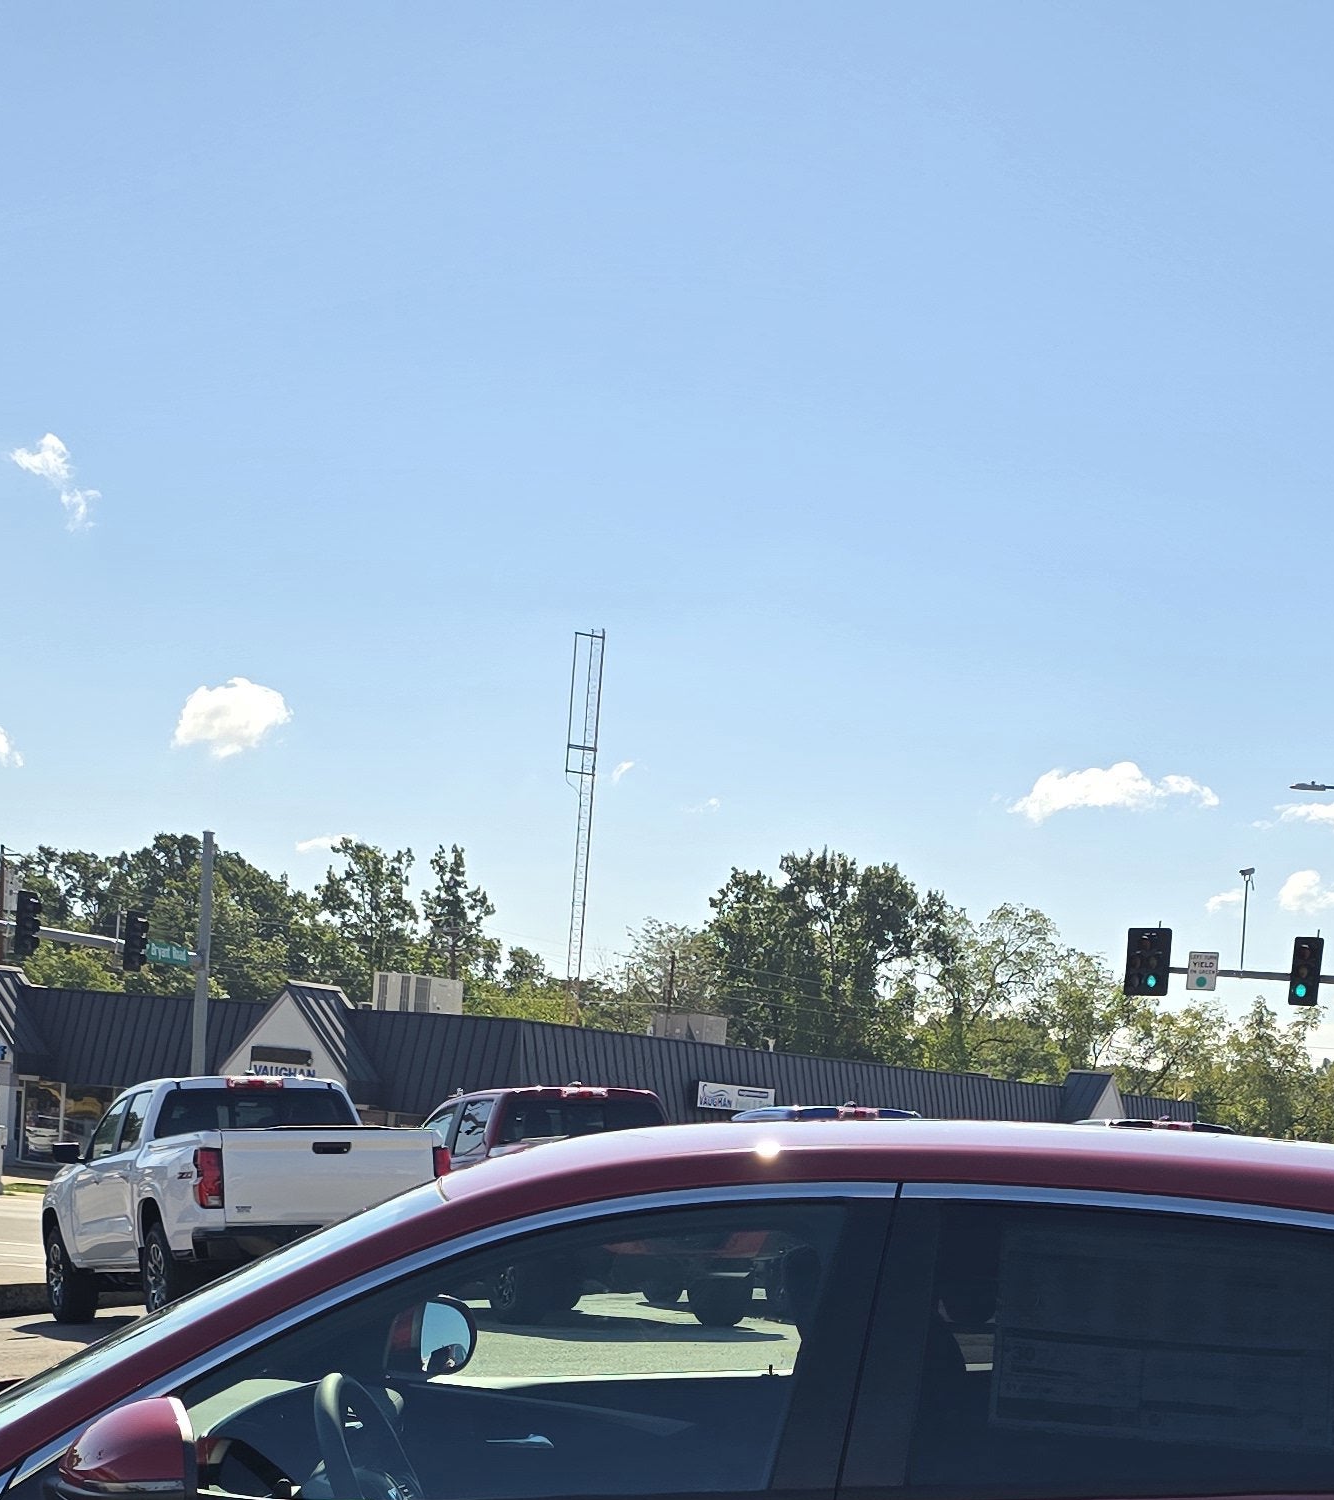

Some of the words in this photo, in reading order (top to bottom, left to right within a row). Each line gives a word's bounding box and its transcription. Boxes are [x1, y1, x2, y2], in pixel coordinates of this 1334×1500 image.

[1193, 961, 1215, 969] YIELD
[253, 1064, 316, 1078] VAUGHAN
[699, 1096, 733, 1109] VAUGHAN
